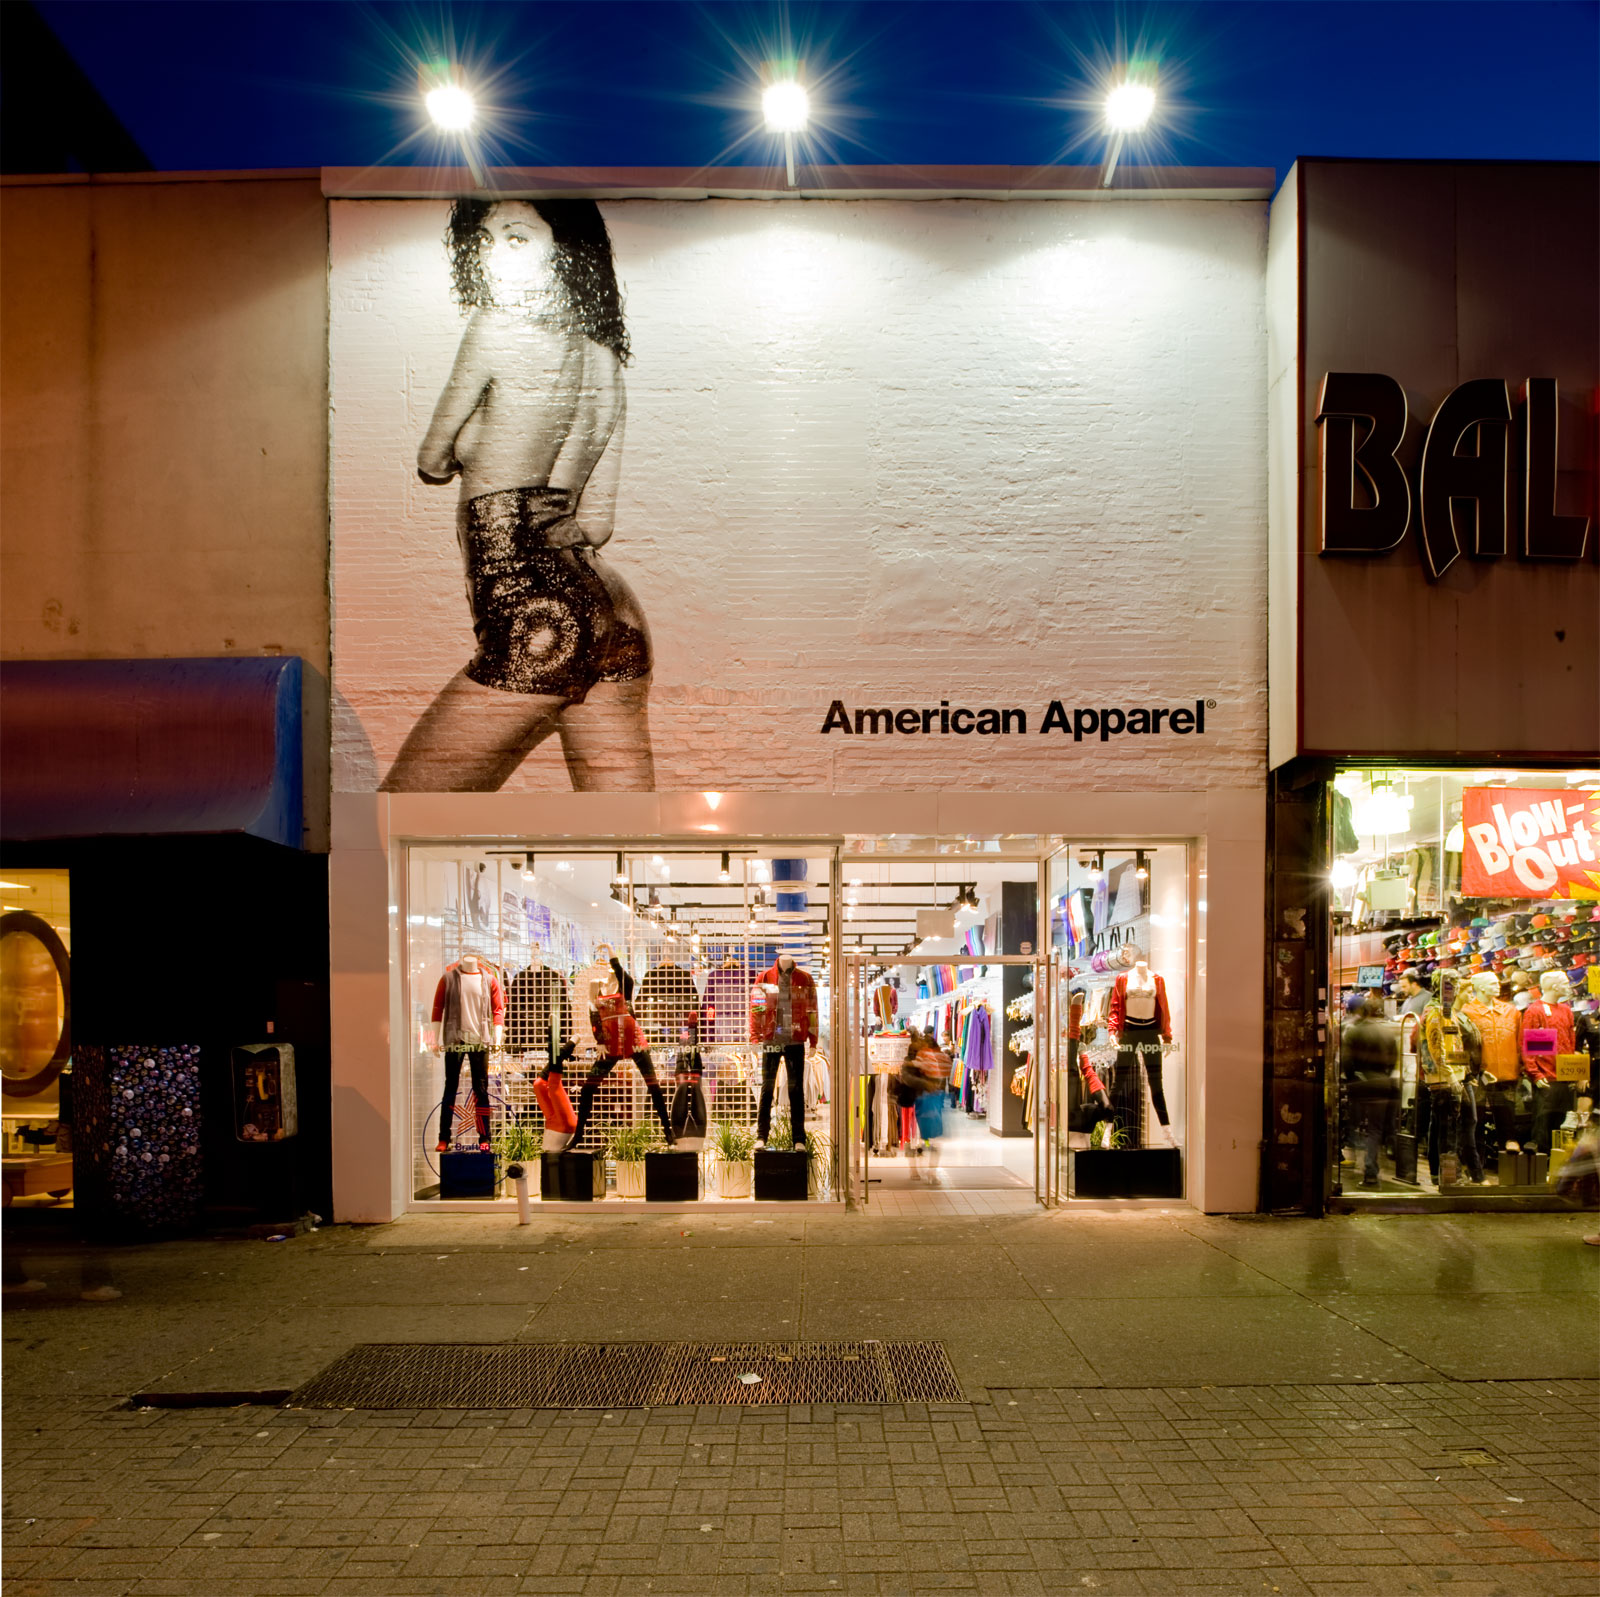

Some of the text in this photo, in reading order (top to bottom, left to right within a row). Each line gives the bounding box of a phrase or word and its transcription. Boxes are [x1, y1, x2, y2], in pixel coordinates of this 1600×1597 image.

[820, 700, 1027, 734] American
[1512, 819, 1596, 891] Out
[477, 1042, 521, 1055] Appa
[1135, 1042, 1180, 1055] Apparel
[1560, 1067, 1586, 1076] $29.99
